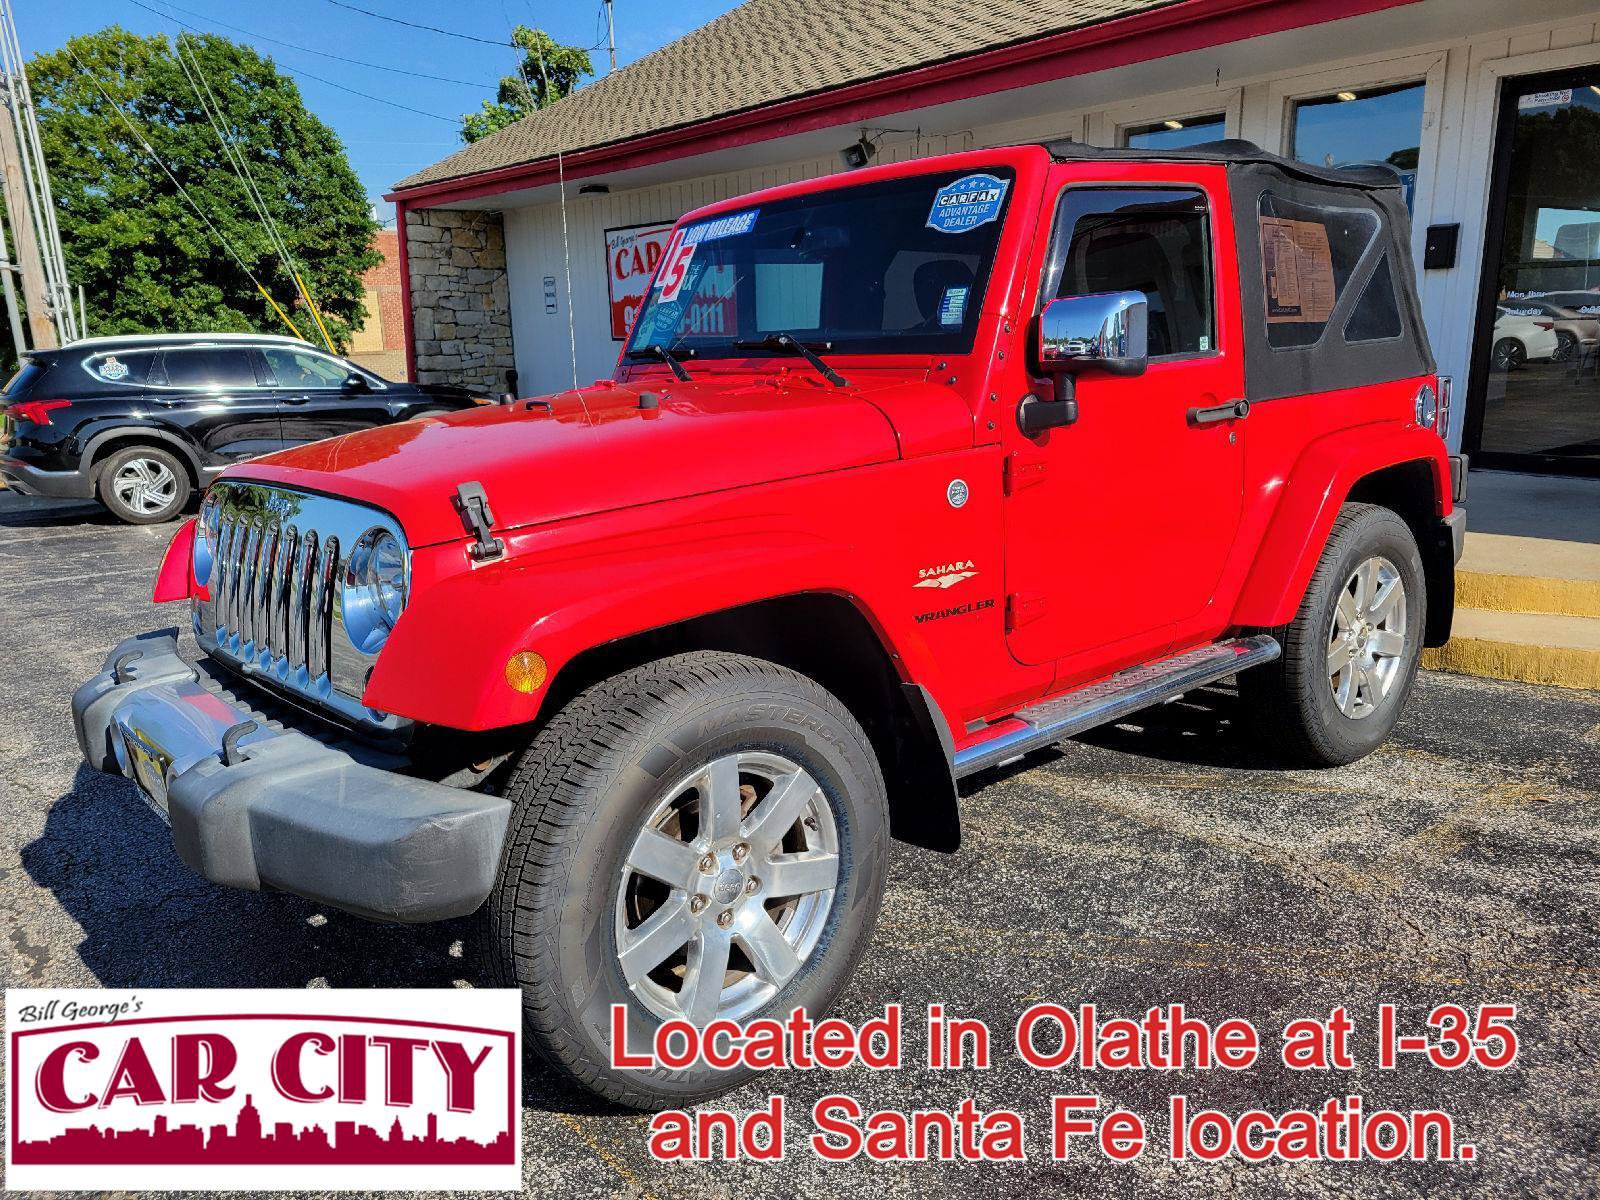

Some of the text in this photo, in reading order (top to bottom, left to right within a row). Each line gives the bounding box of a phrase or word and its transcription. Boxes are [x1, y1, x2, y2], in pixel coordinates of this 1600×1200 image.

[940, 189, 999, 207] CARFAX
[939, 204, 991, 218] ADVANTAGE
[684, 212, 756, 244] LOW MILEAGE
[943, 216, 977, 228] DEALER
[1505, 307, 1543, 316] Saturday
[918, 559, 975, 579] SAHARA
[914, 598, 995, 624] WRANGLER
